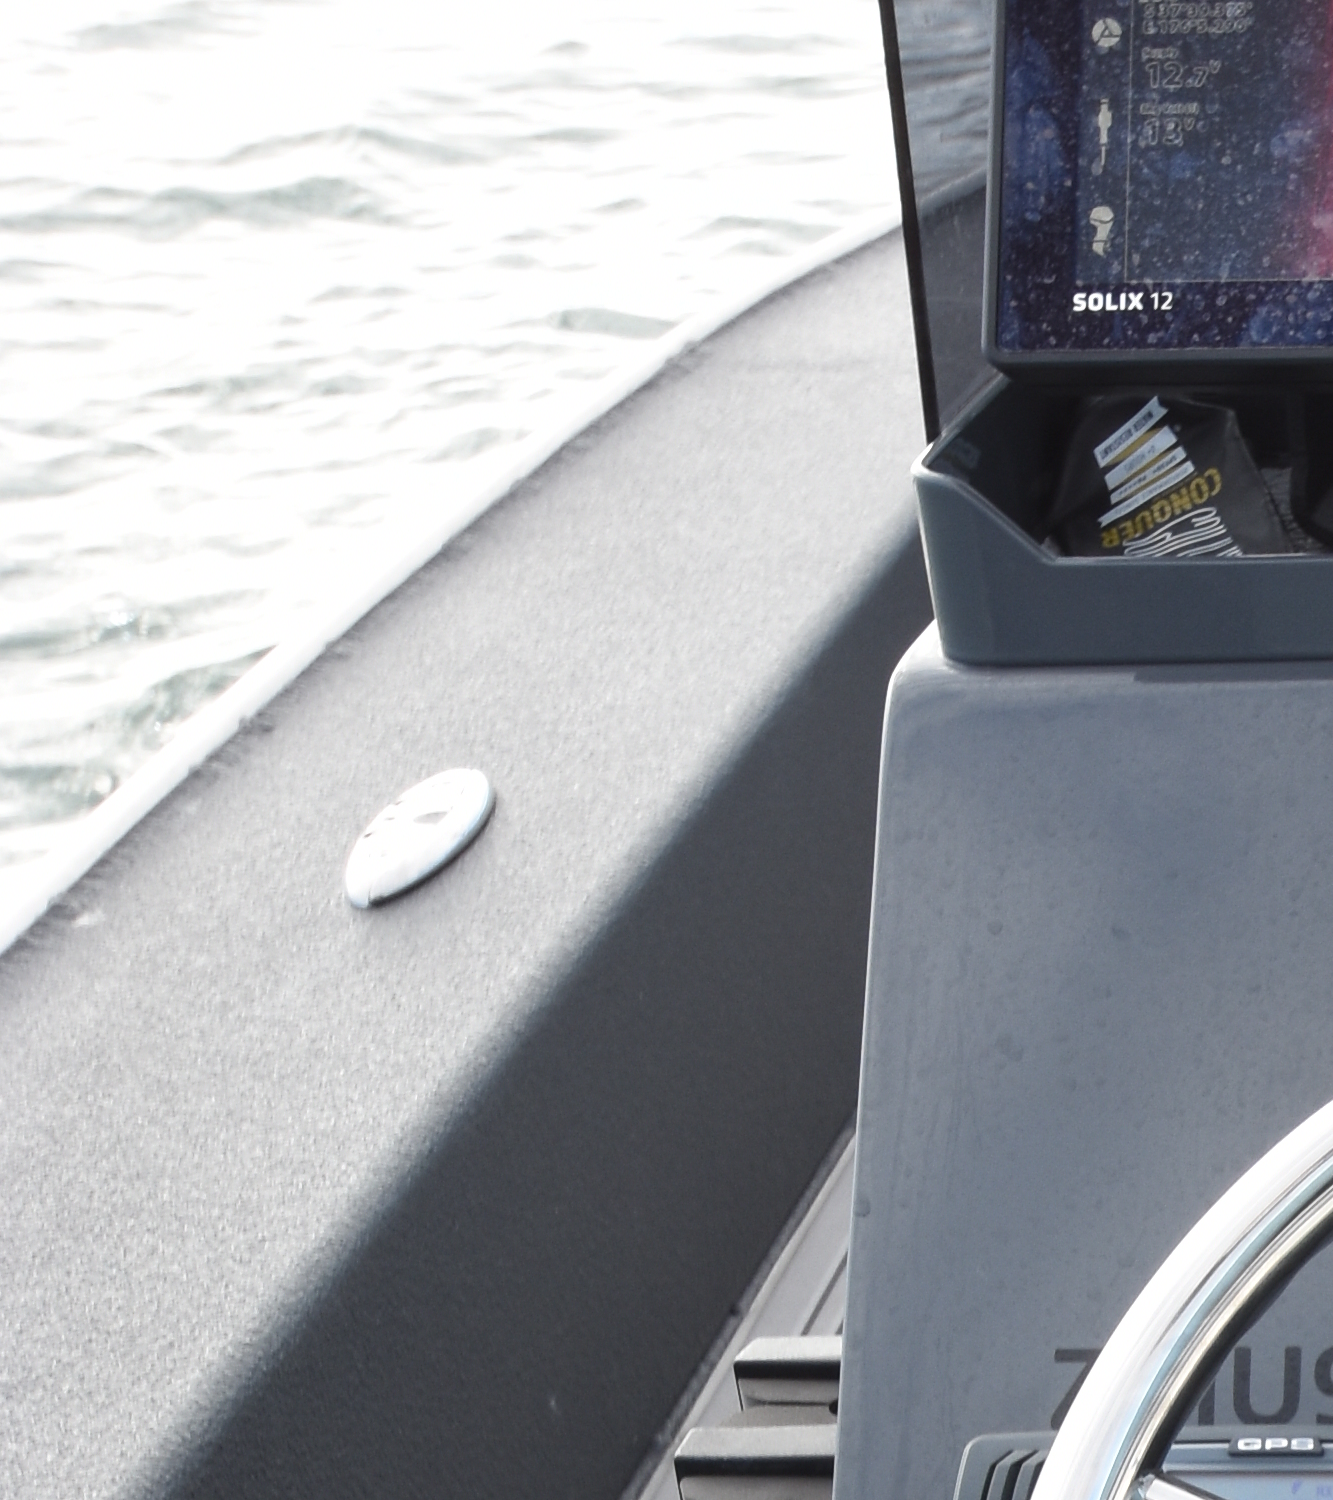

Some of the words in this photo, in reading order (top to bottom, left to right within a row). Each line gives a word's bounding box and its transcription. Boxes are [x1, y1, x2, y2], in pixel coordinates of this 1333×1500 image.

[1073, 292, 1144, 312] SOLIX
[1150, 292, 1173, 311] 12
[1100, 467, 1222, 548] CONQUER
[1237, 1437, 1315, 1450] GPS
